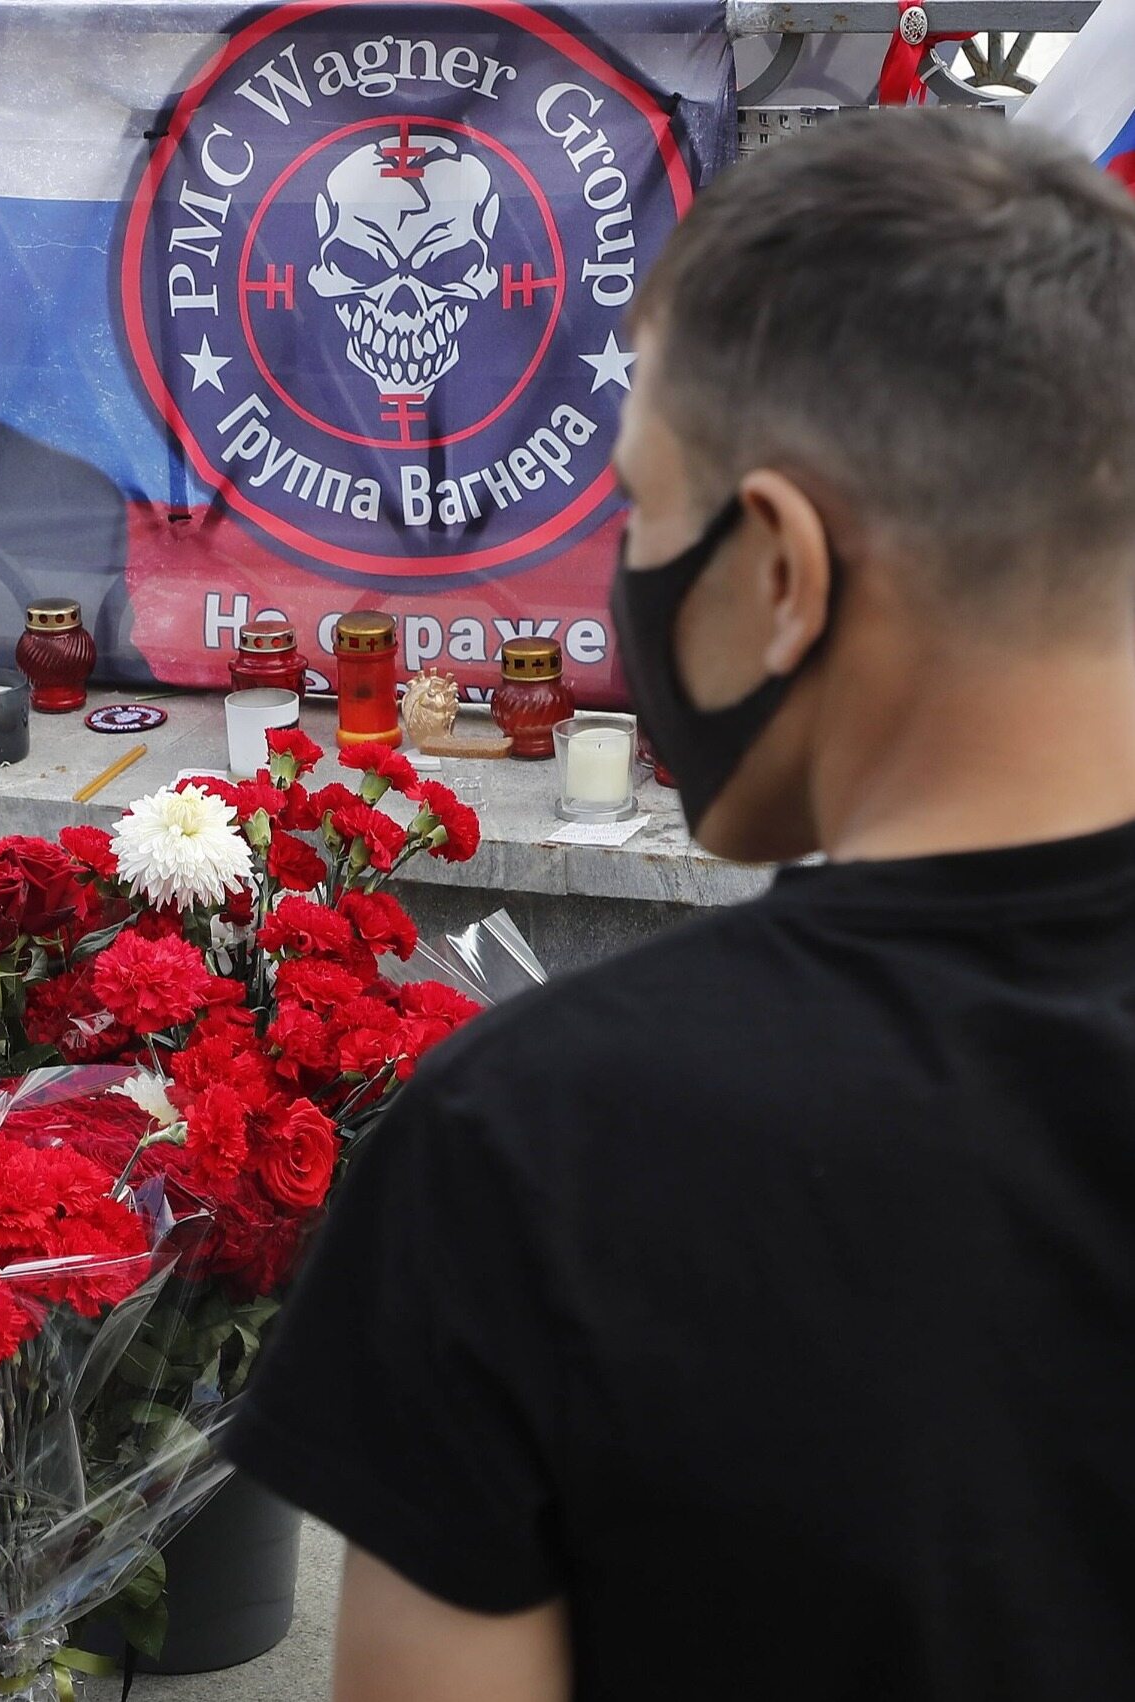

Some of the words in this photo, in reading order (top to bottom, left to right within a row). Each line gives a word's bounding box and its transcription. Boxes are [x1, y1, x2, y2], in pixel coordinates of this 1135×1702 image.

[169, 125, 254, 317] PMC
[234, 34, 518, 127] Wagner
[535, 82, 635, 308] Group
[216, 391, 382, 523] Группа
[400, 402, 598, 527] Вагнера
[318, 613, 607, 671] сраже
